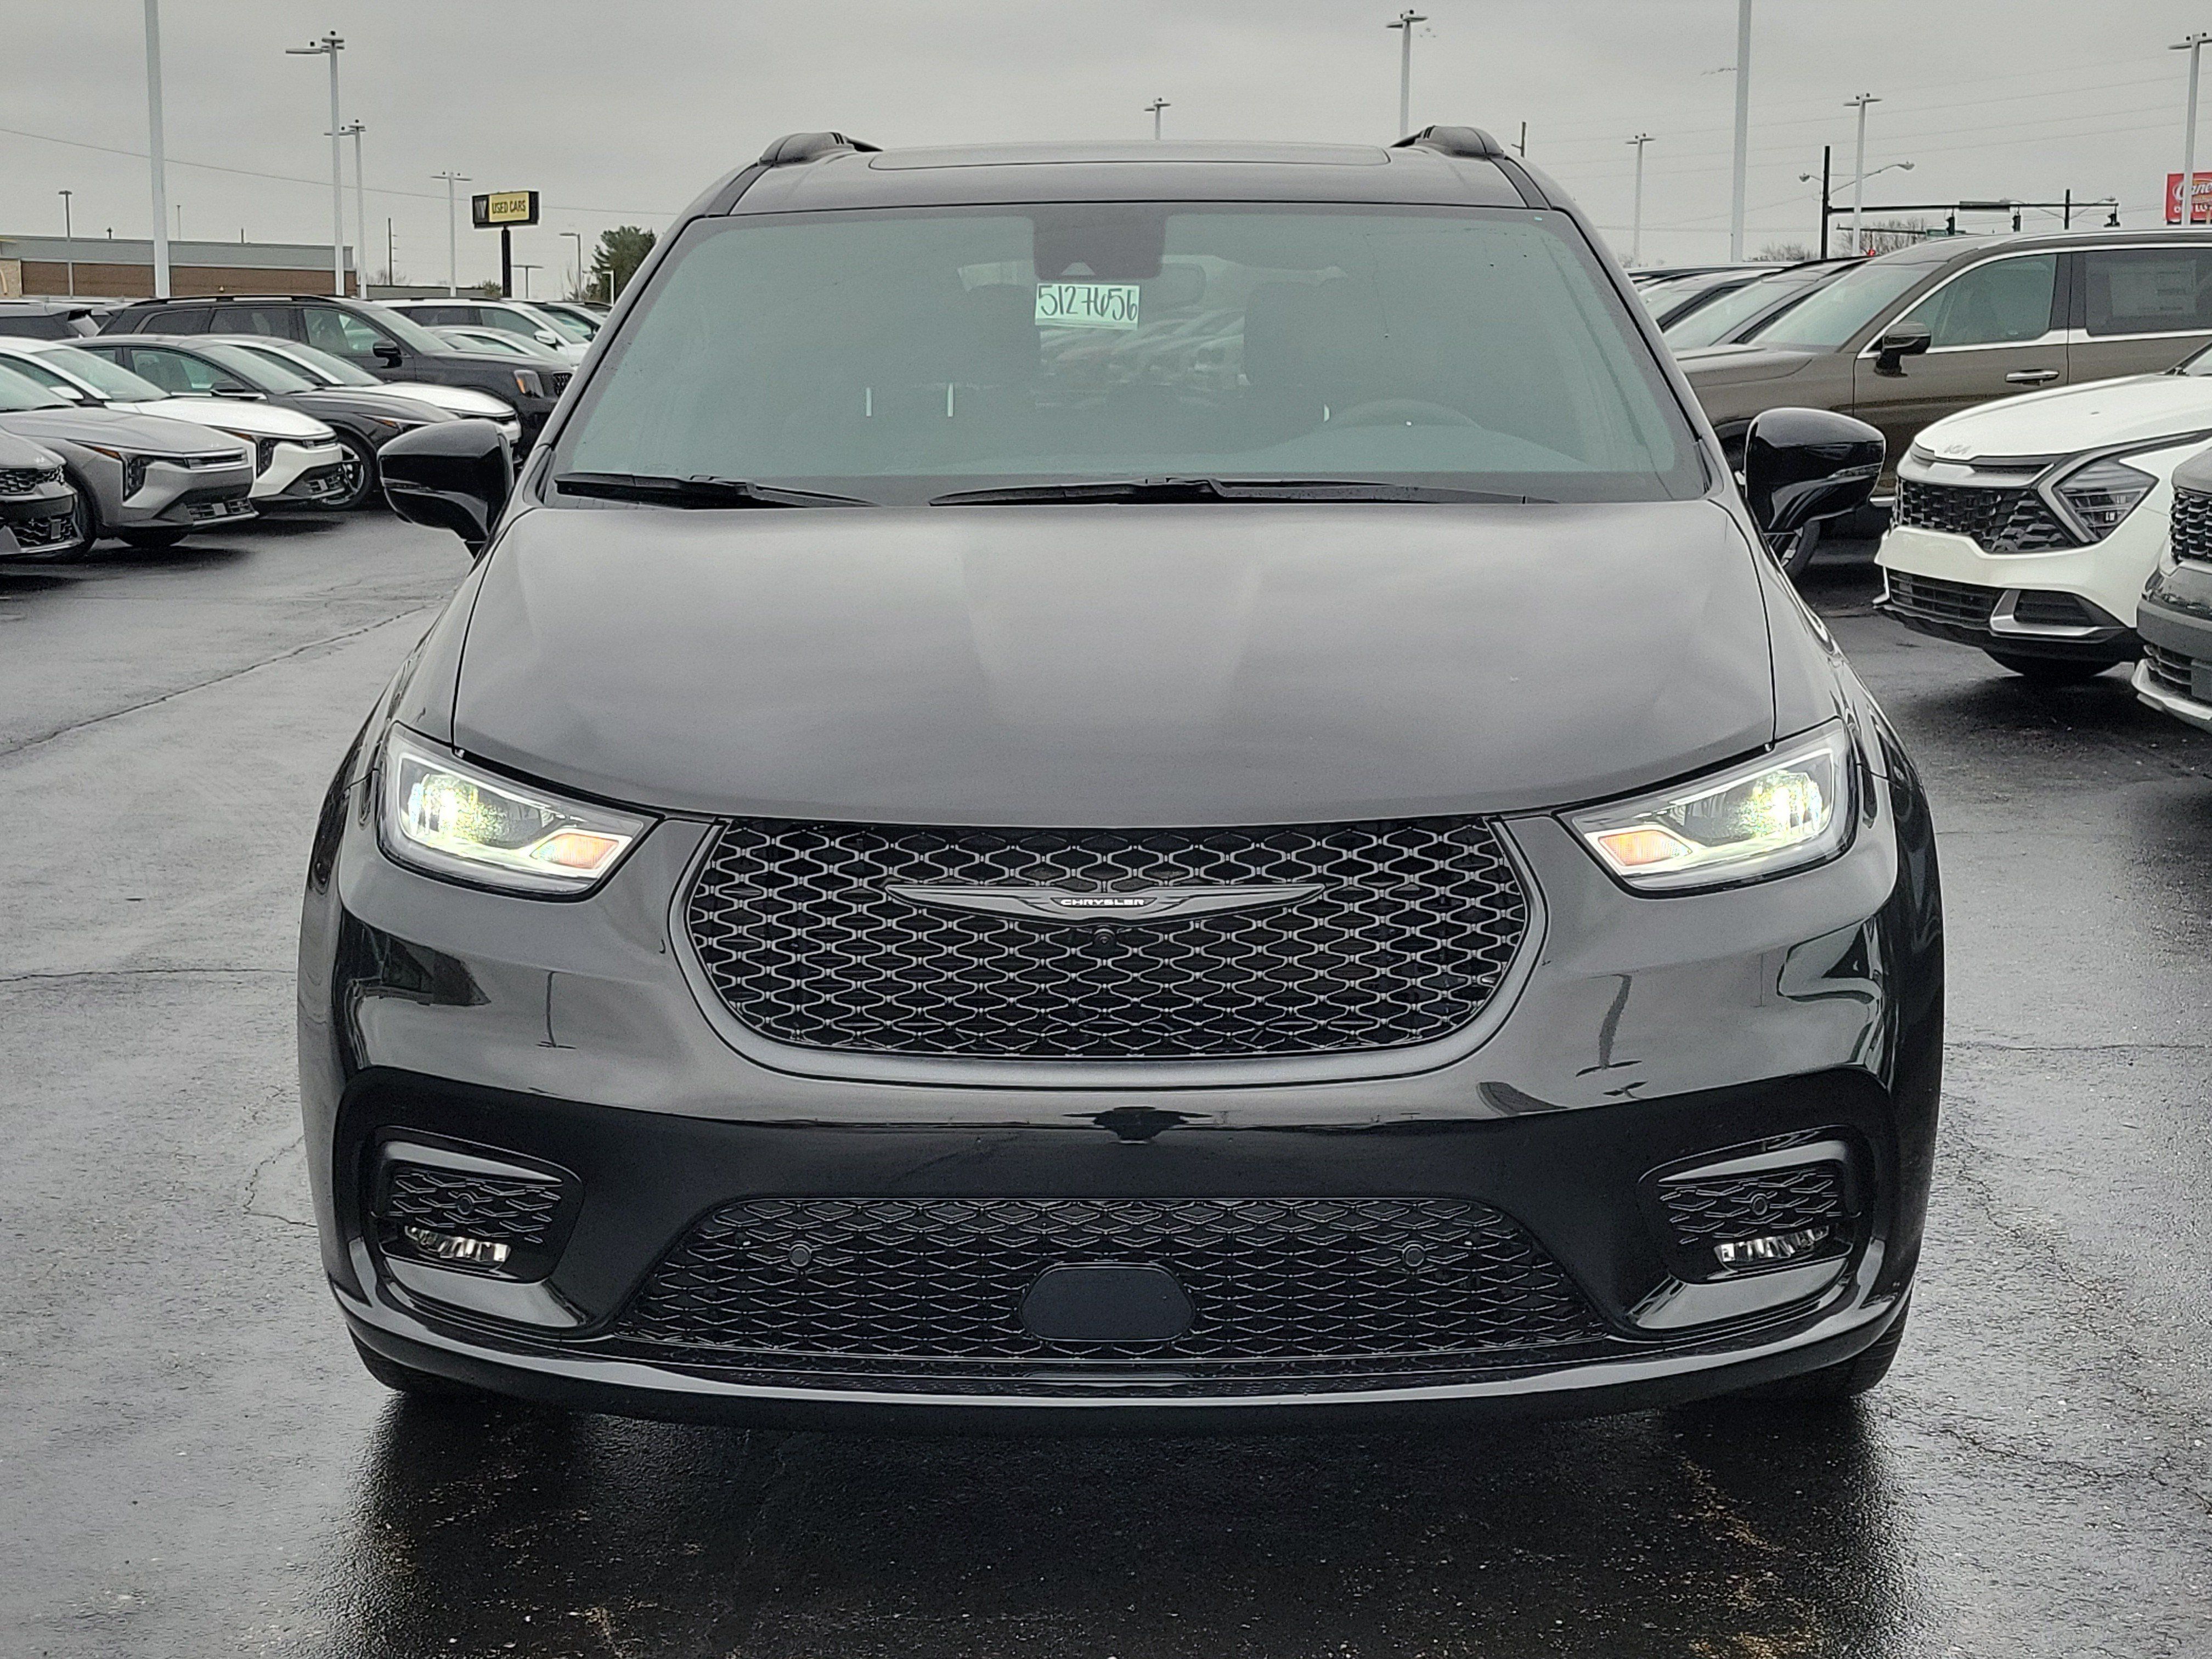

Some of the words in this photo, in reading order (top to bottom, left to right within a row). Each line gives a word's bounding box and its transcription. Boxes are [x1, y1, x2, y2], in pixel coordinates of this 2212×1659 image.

[492, 201, 508, 214] USED
[510, 200, 526, 213] CARS
[1038, 285, 1138, 321] 5127656
